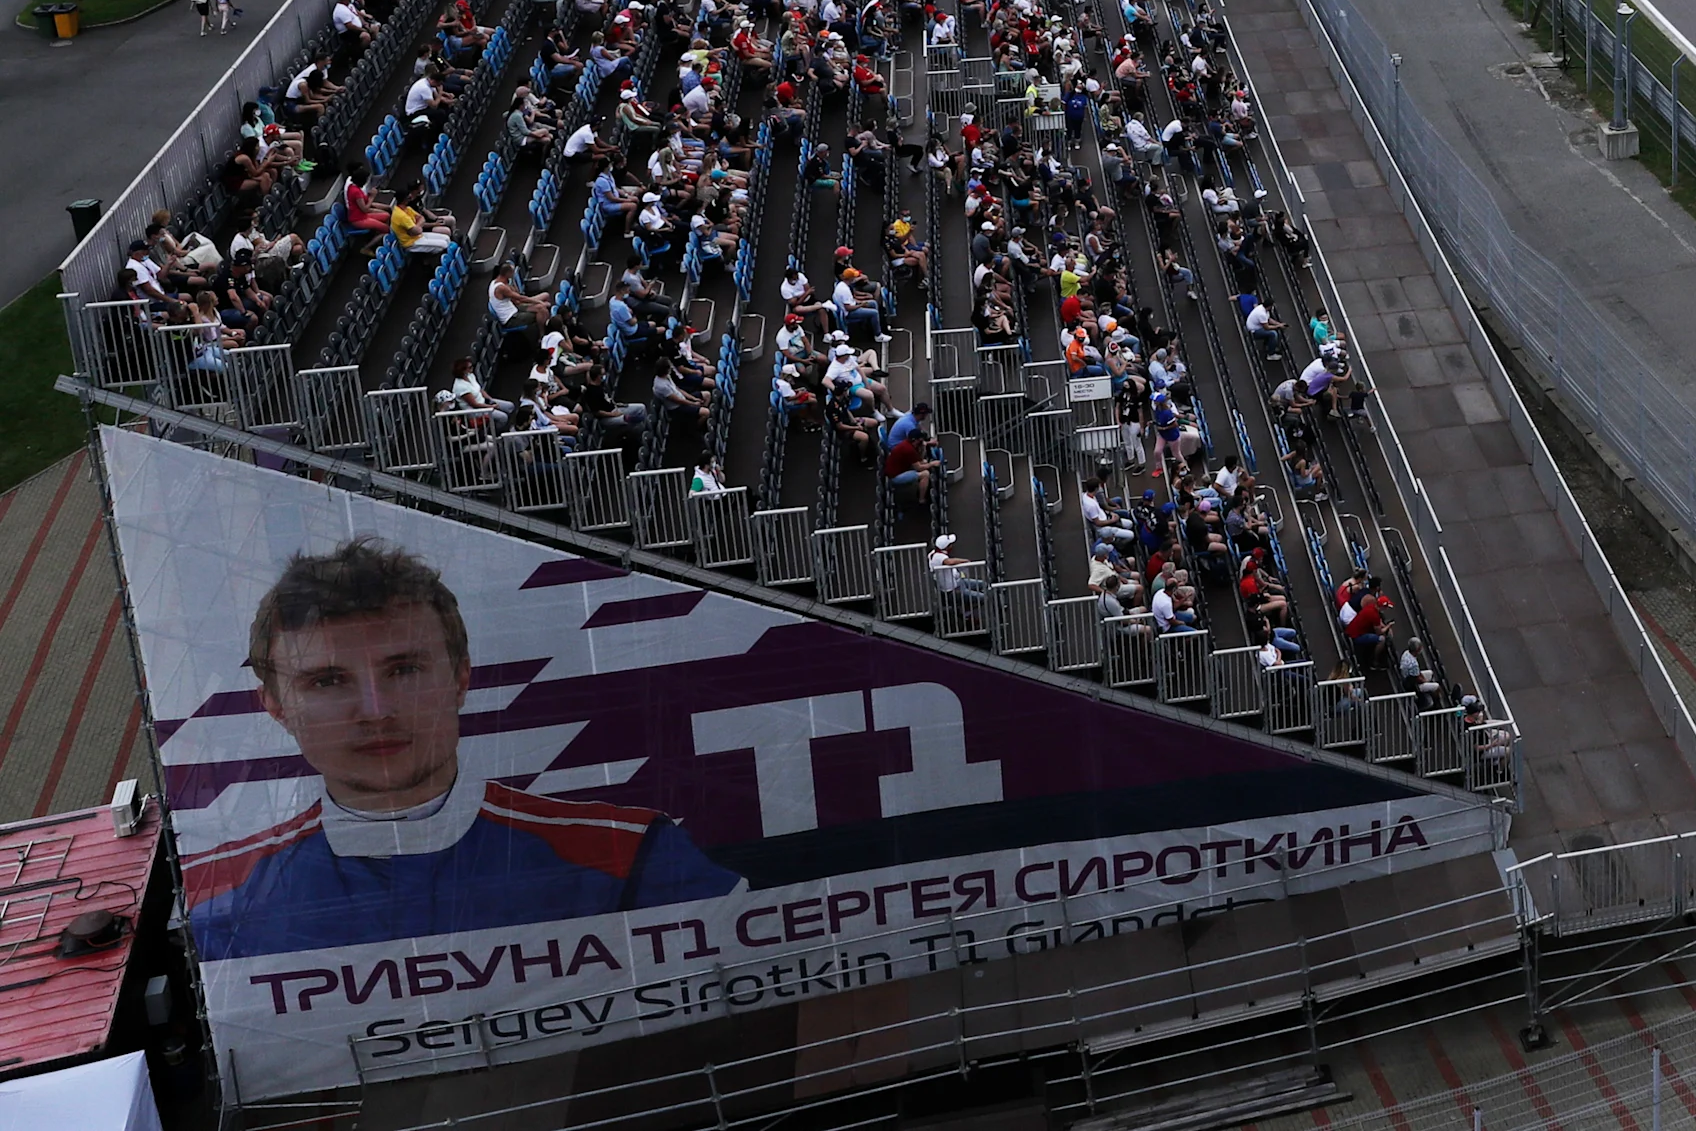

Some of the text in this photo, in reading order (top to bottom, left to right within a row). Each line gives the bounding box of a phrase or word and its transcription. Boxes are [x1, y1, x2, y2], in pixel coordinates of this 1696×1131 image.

[250, 933, 622, 1015] ТРИБУНА
[735, 869, 997, 948] СЕРГЕЯ
[1015, 815, 1431, 903] СИРОТКИНА
[365, 994, 615, 1058] Sergey
[633, 950, 892, 1020] Sirotkin
